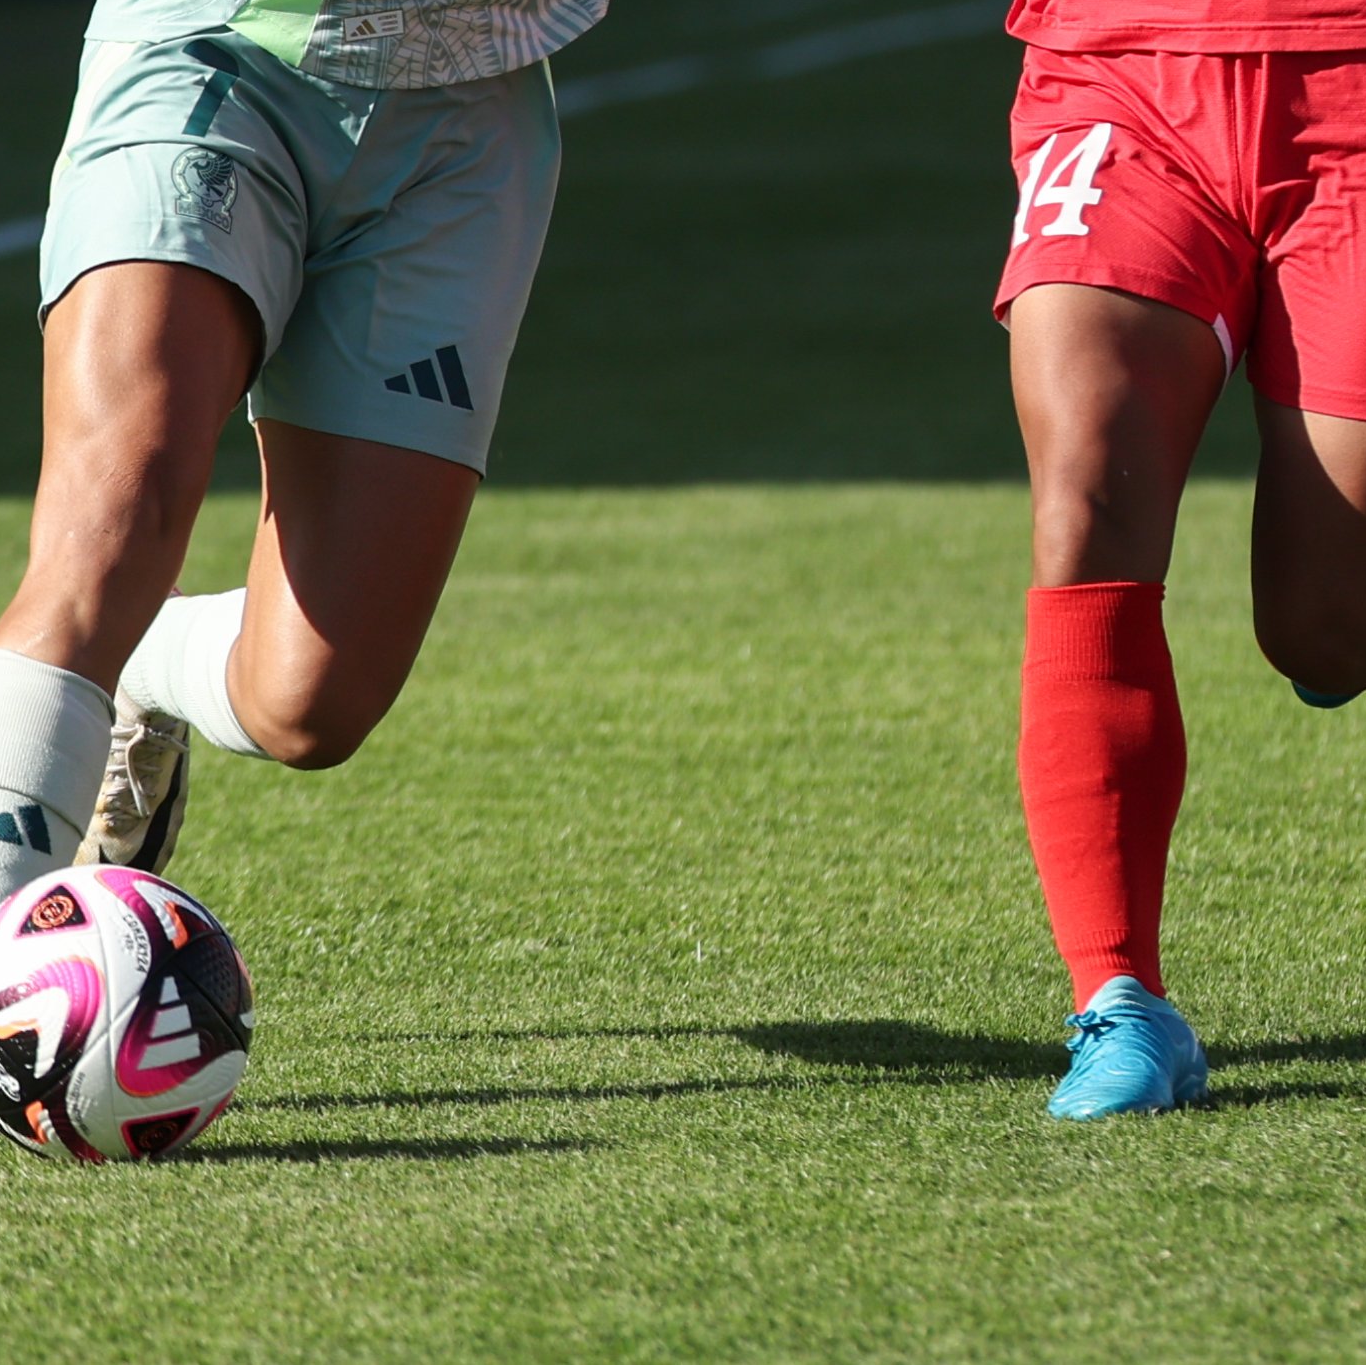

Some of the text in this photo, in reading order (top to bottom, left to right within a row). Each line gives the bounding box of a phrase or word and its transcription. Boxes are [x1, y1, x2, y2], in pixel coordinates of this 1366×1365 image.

[182, 38, 240, 138] 7
[178, 200, 230, 230] MEXICO
[1013, 122, 1112, 249] 14
